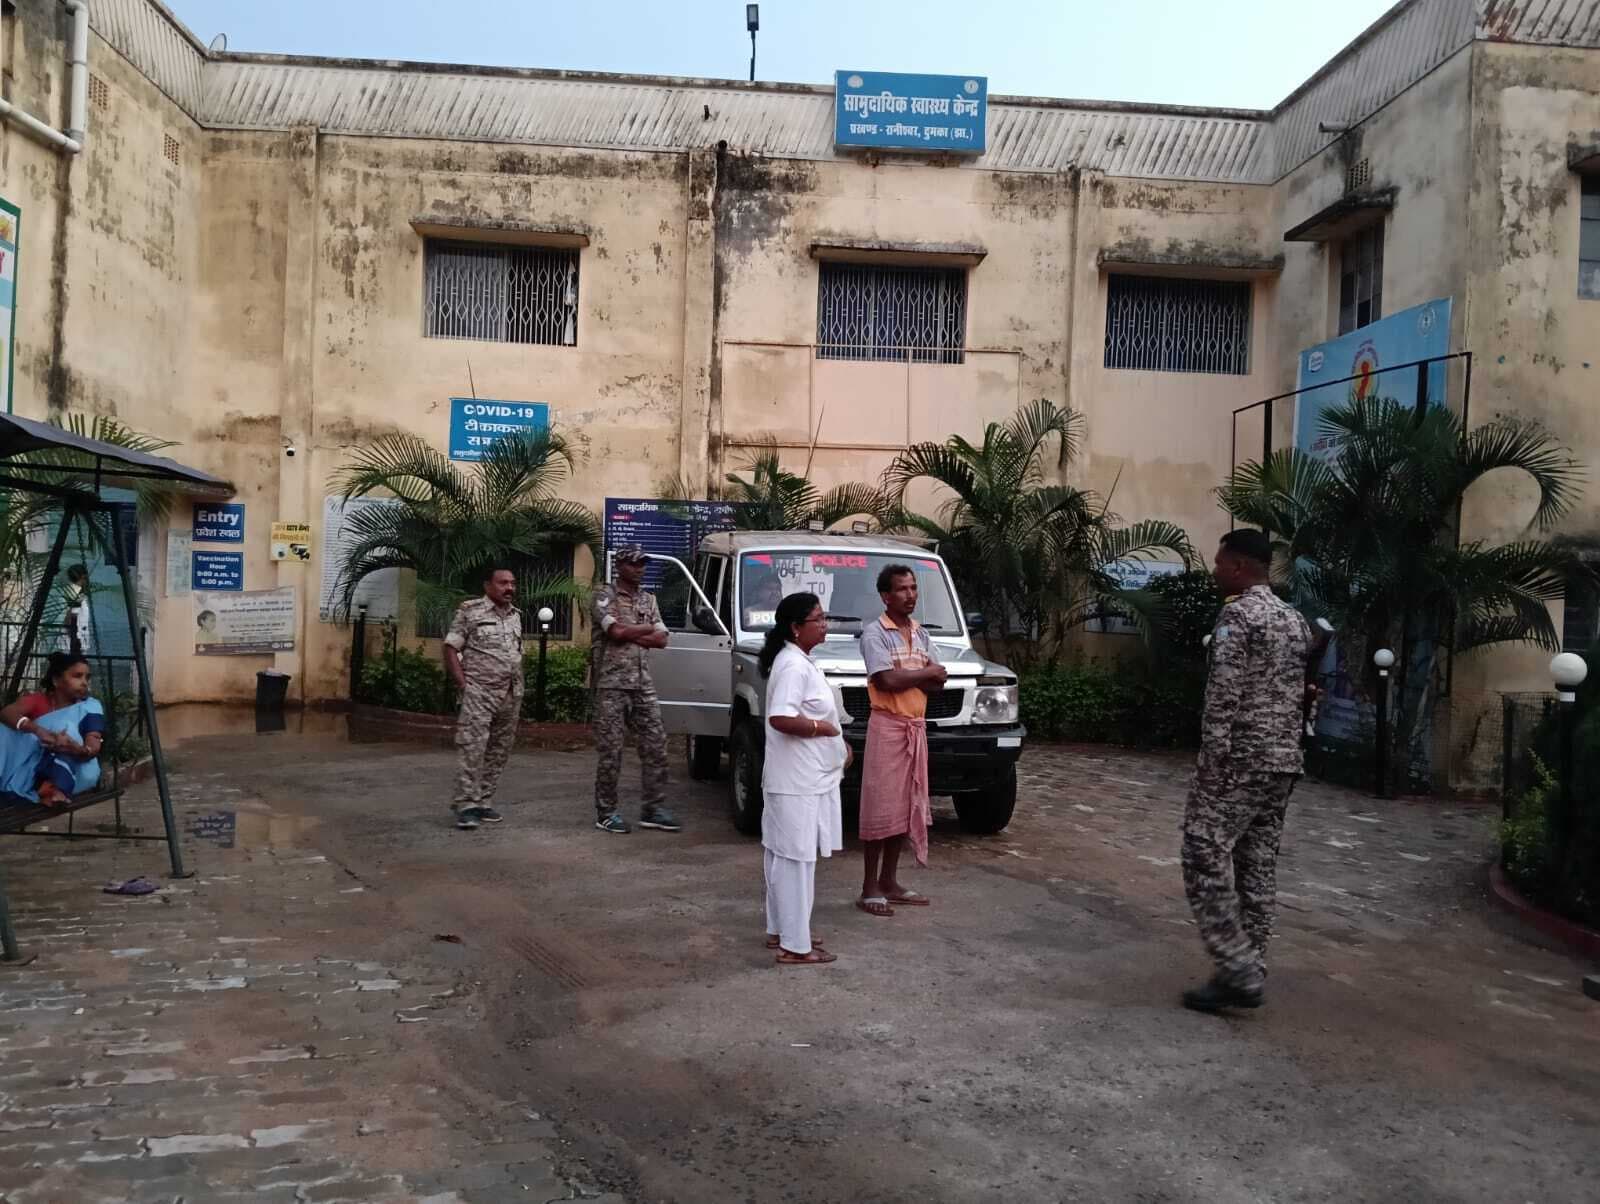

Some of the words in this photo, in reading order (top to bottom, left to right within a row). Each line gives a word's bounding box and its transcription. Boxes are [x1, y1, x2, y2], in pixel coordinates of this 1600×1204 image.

[844, 91, 908, 118] सामुदायिक
[910, 96, 950, 115] स्वास्थ्य
[952, 94, 979, 117] केन्द्र
[923, 126, 948, 140] दुमका
[463, 404, 534, 419] COVID-19
[617, 502, 659, 513] सामुदायिक
[197, 510, 240, 526] Entry
[195, 526, 217, 537] प्रवेश
[218, 528, 240, 538] स्थल
[810, 553, 868, 568] POLICE
